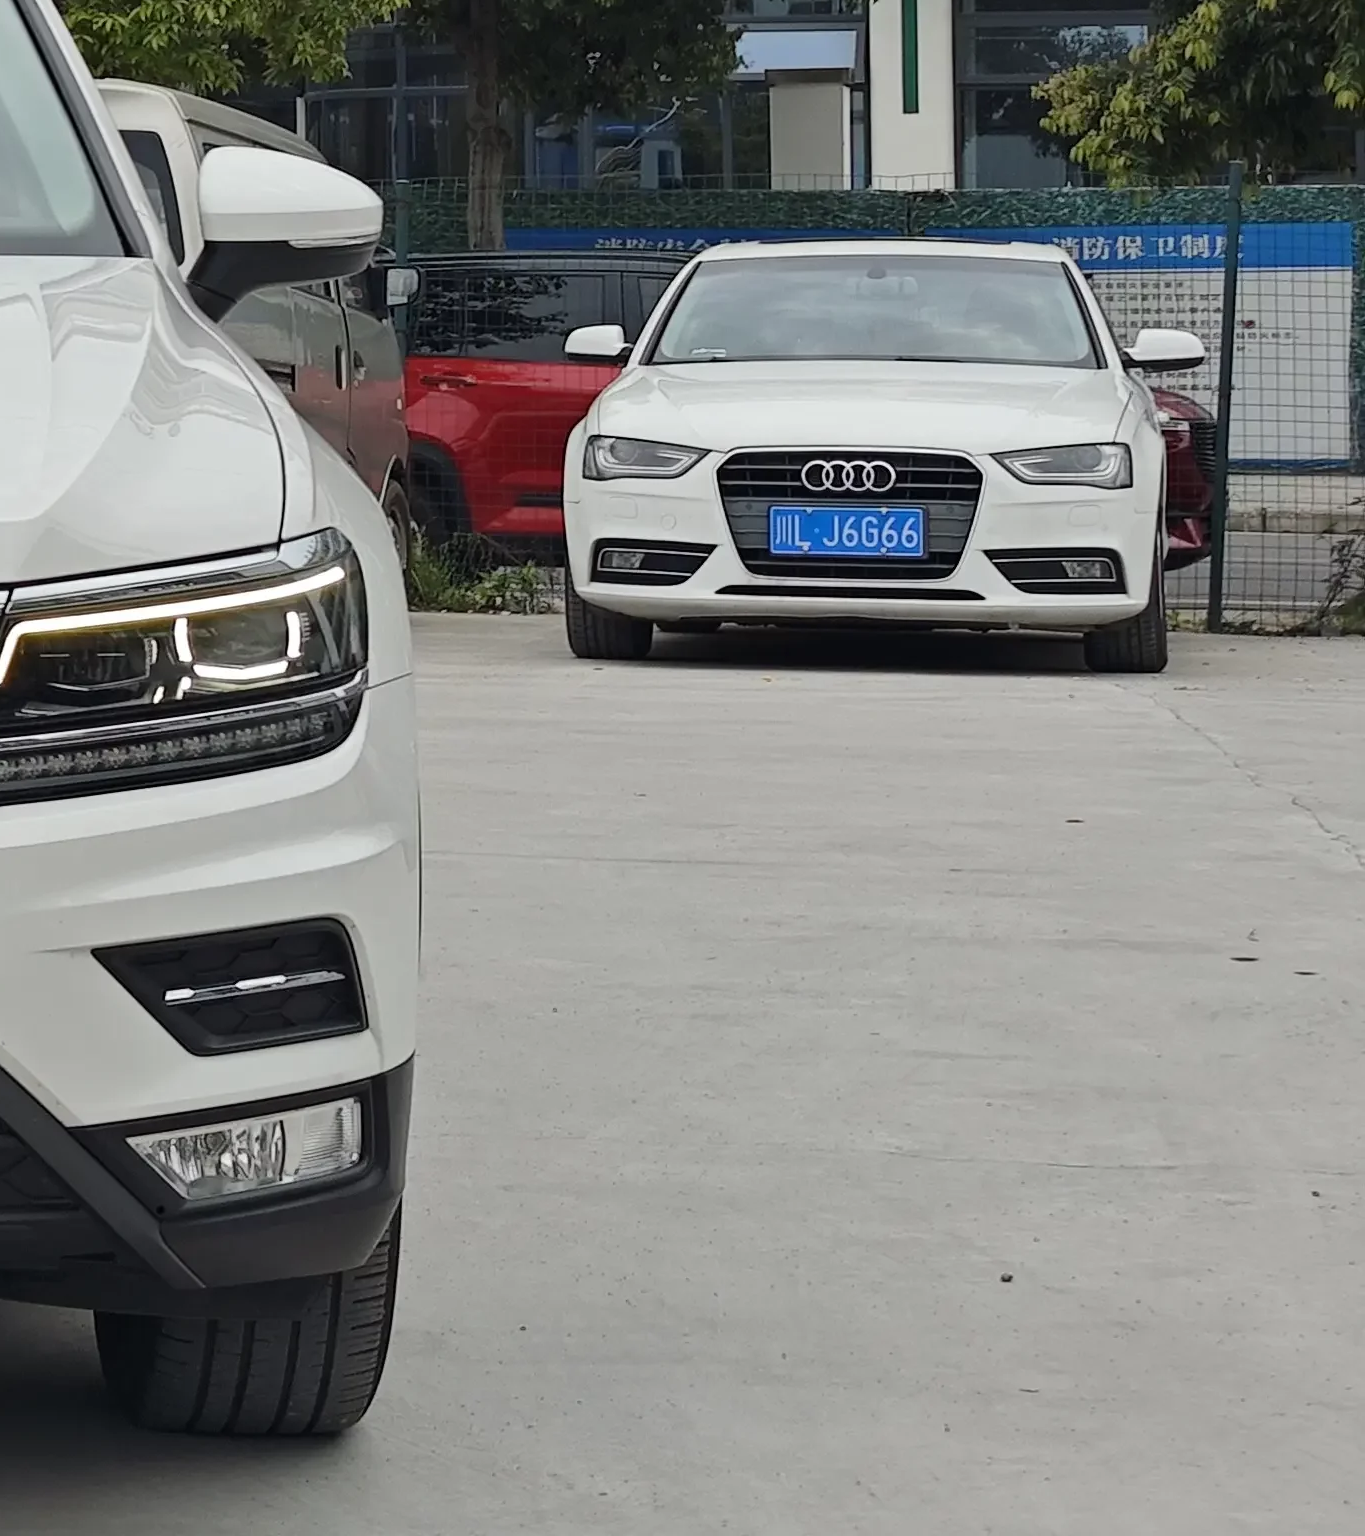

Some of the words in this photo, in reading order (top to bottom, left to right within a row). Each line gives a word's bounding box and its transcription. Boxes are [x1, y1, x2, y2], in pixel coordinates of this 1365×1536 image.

[1052, 234, 1245, 261] 消防保卫制度
